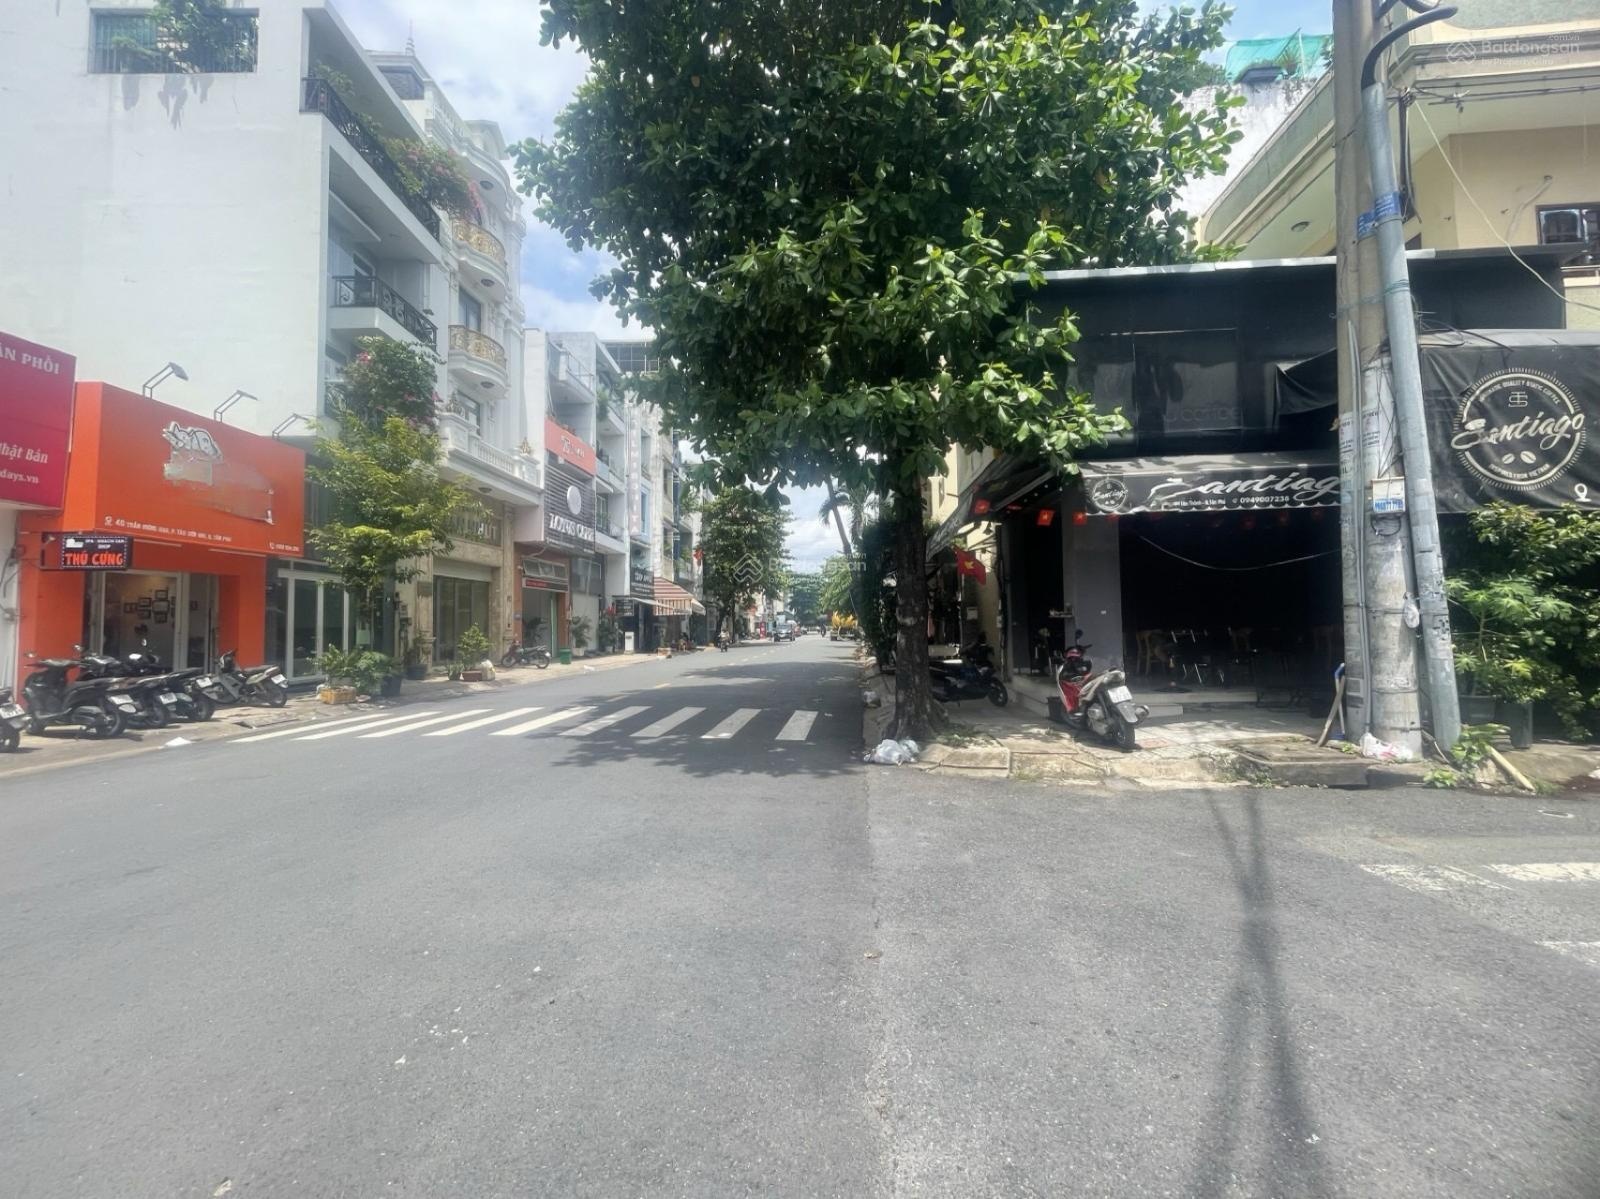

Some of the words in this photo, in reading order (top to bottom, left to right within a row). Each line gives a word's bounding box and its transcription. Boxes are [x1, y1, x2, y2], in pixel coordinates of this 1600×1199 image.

[1451, 411, 1585, 450] Santiago
[0, 442, 22, 460] hật
[25, 447, 49, 464] Bản
[1147, 472, 1341, 503] Santiag
[65, 550, 88, 566] THÚ
